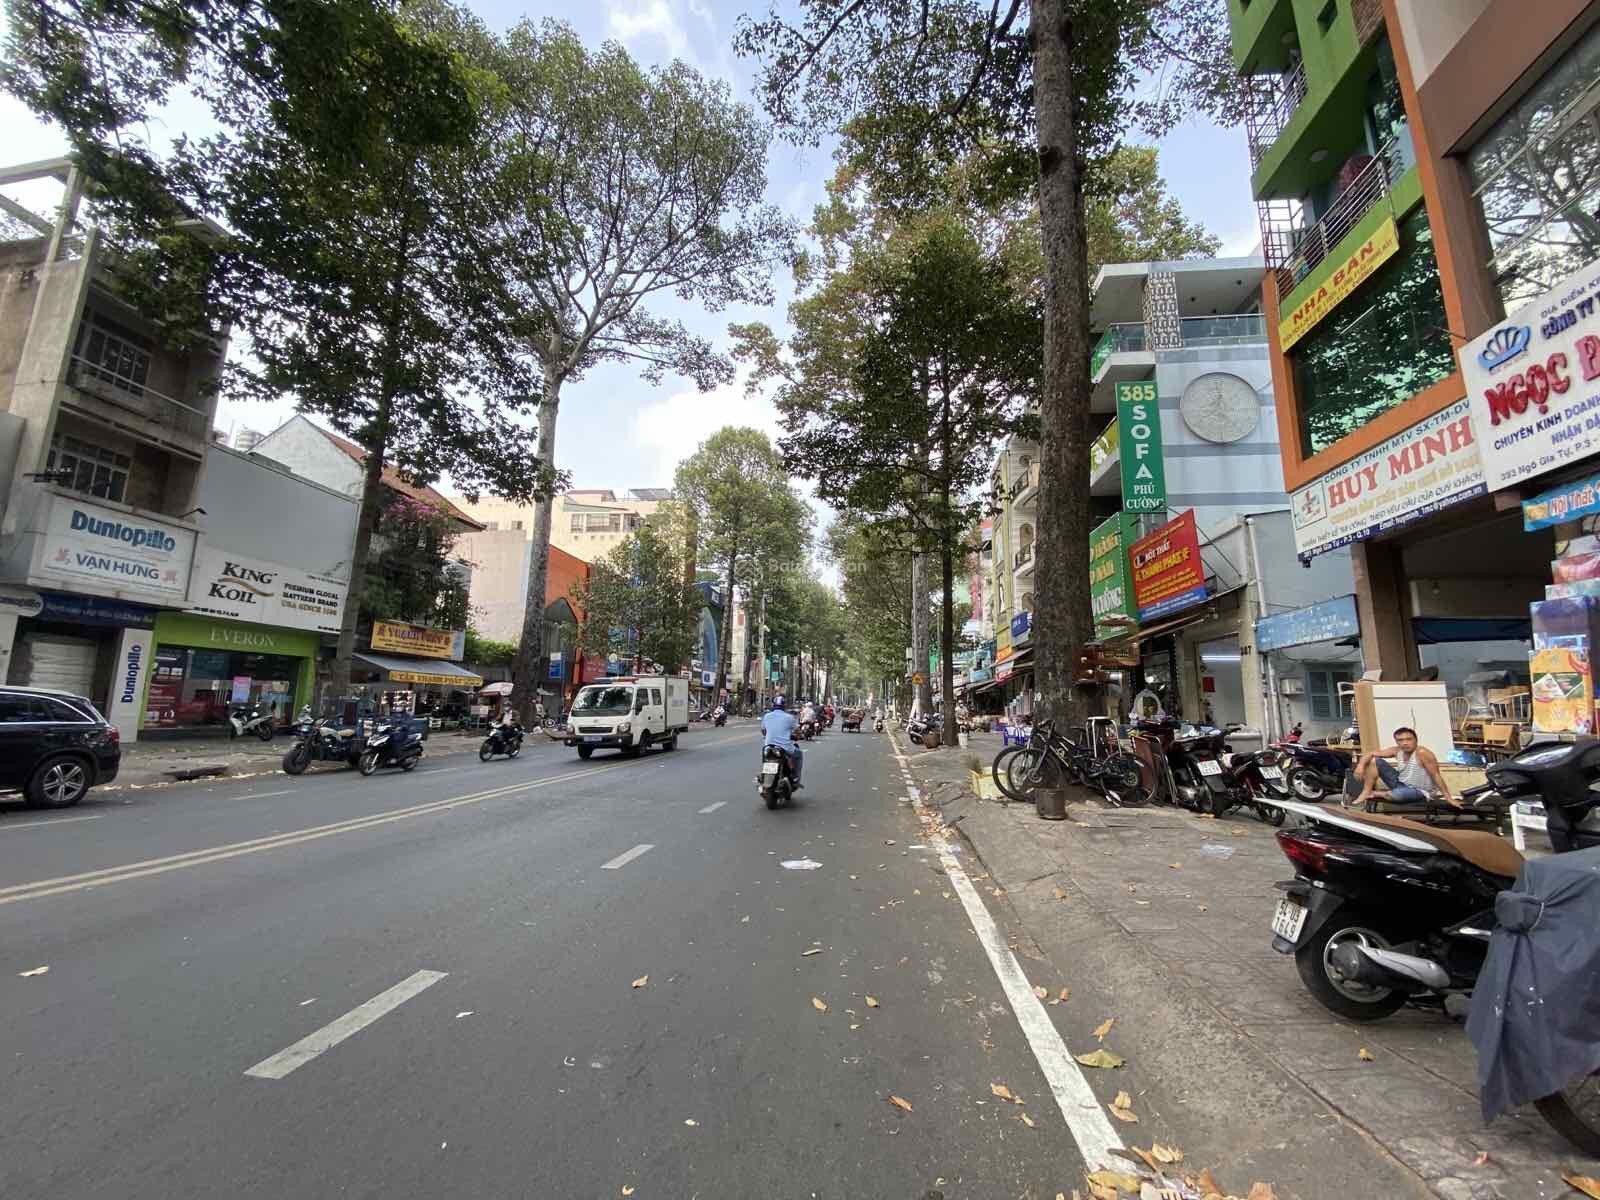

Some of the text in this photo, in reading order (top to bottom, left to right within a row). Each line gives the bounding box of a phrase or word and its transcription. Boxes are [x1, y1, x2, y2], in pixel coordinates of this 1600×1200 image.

[1120, 384, 1155, 402] 385
[1484, 352, 1570, 426] NGỌC
[1130, 404, 1153, 479] SOFA
[1494, 424, 1534, 450] CHUYÊN
[1535, 411, 1562, 433] KINH
[1363, 445, 1389, 463] TNHH
[1391, 432, 1413, 448] MTV
[1327, 461, 1379, 509] HUY
[1387, 415, 1474, 481] MINH
[1133, 482, 1155, 495] PHÚ
[1126, 494, 1165, 510] CƯỜNG
[70, 509, 176, 553] Dunlopillo
[75, 552, 112, 572] VẠN
[221, 560, 273, 585] KING
[207, 581, 257, 605] KOIL
[317, 597, 338, 608] BRAND
[210, 626, 277, 648] EVERON
[121, 644, 142, 704] Dunlopillo
